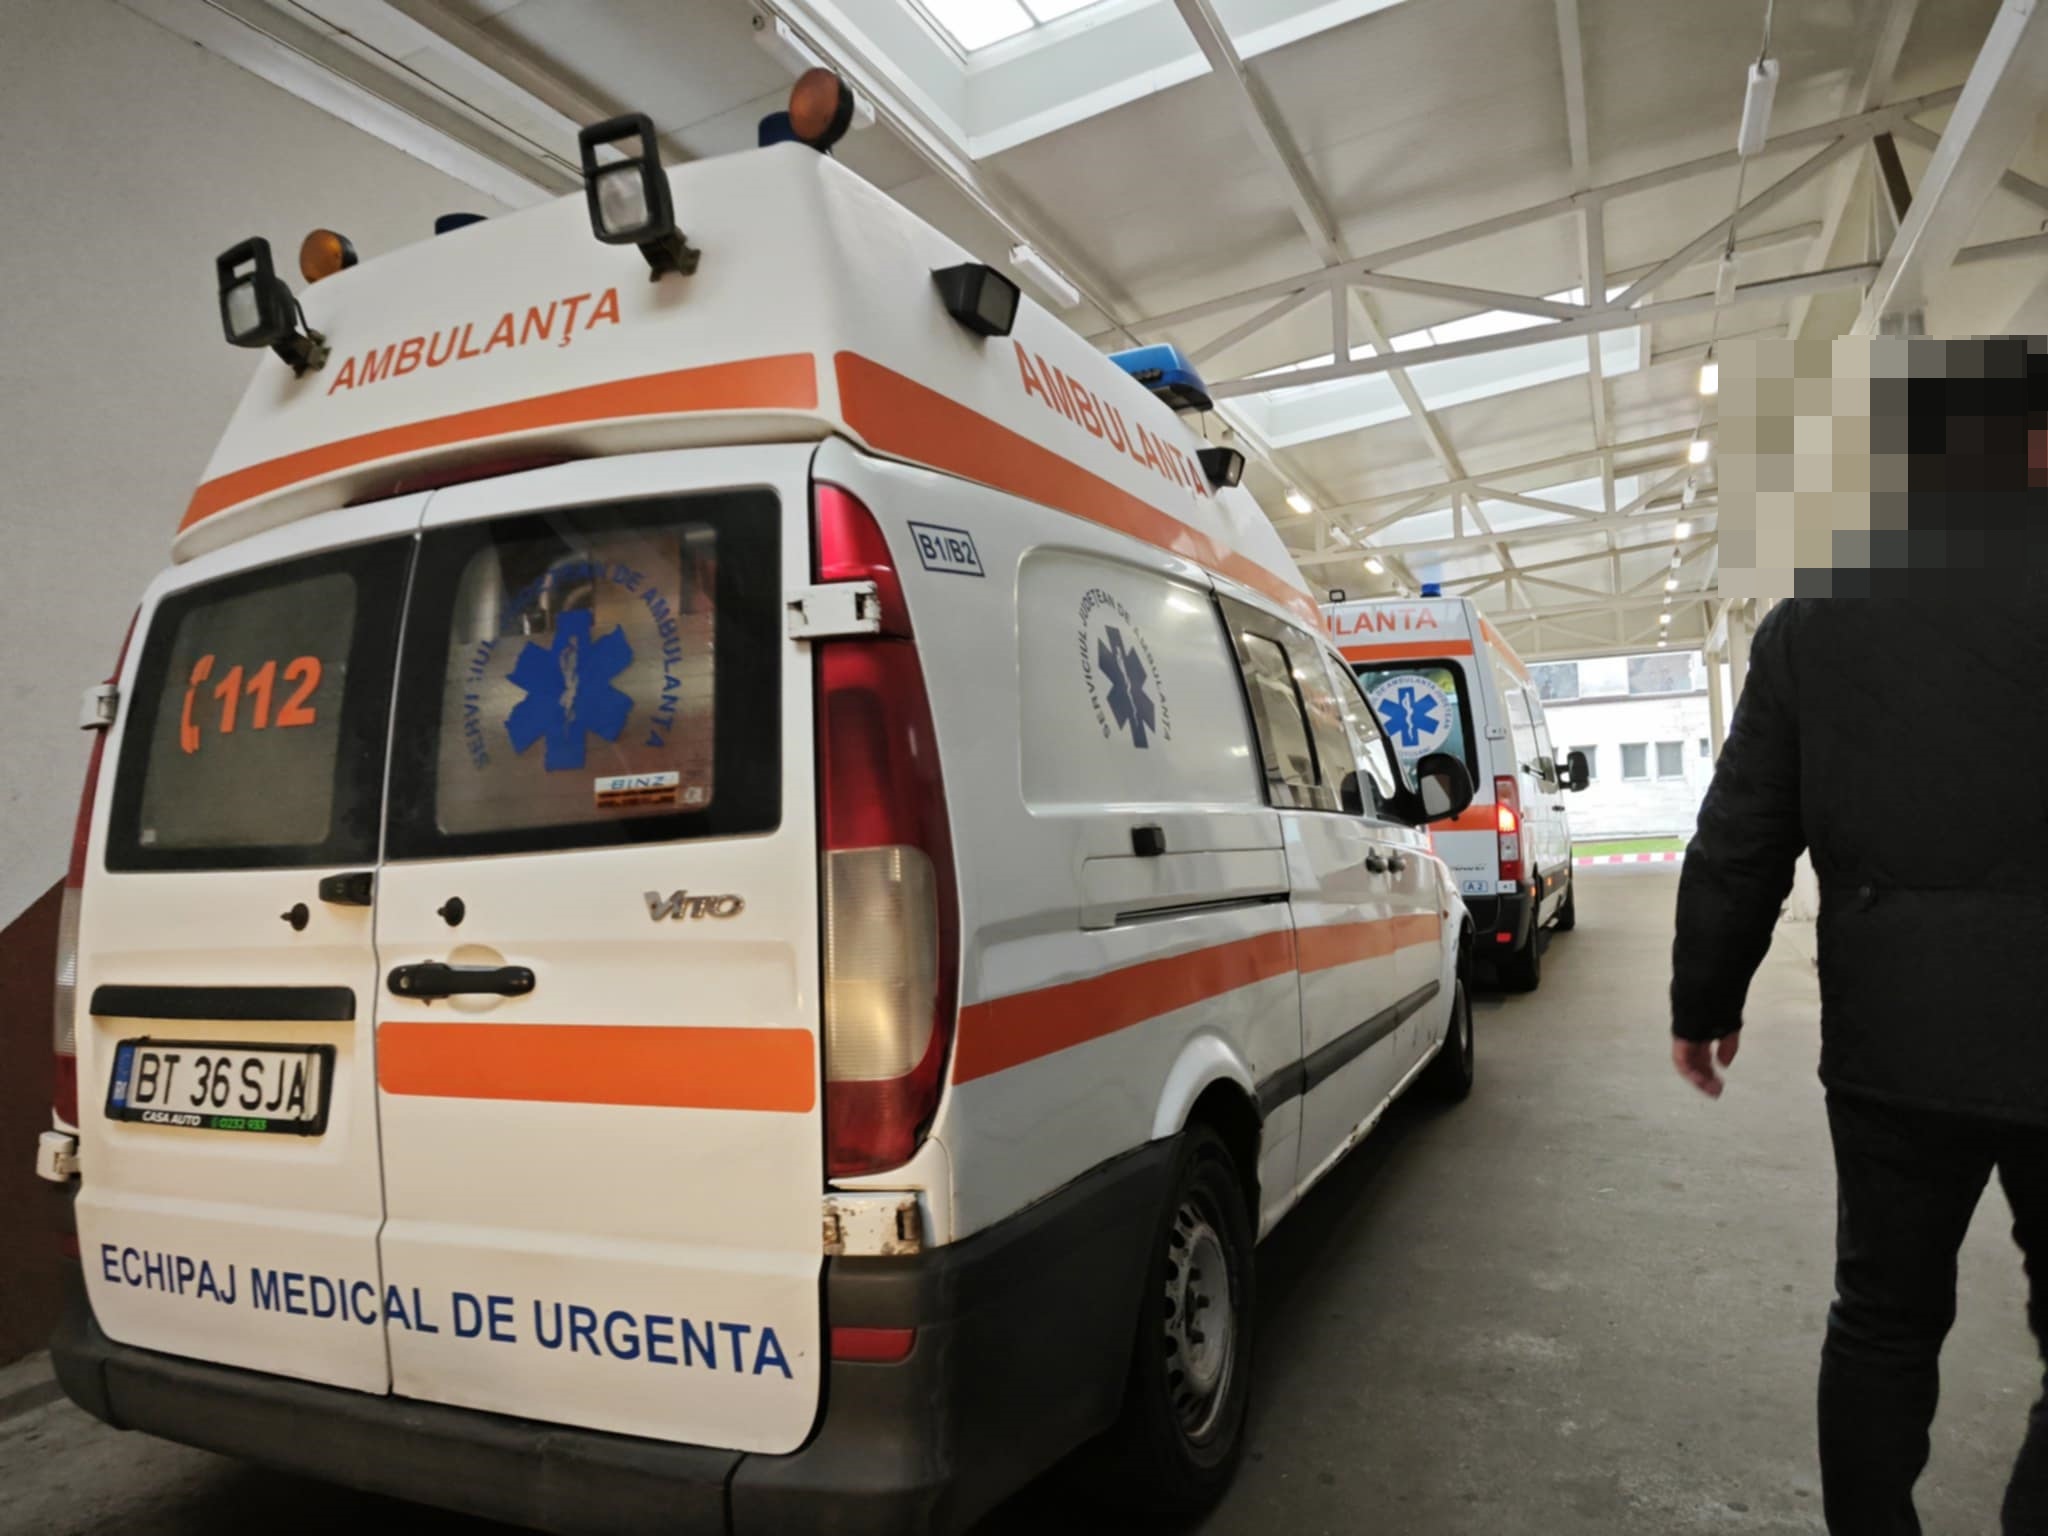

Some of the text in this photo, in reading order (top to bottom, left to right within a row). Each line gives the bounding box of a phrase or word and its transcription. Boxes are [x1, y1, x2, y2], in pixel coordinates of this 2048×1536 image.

[918, 533, 977, 566] B1/B2
[214, 655, 322, 733] 112
[610, 775, 665, 790] BINZ
[135, 1053, 307, 1113] BT 36 SJA
[142, 1111, 169, 1123] CASA
[171, 1113, 201, 1126] AUTO
[101, 1243, 793, 1379] ECHIPAJ MEDICAL DE URGENTA
